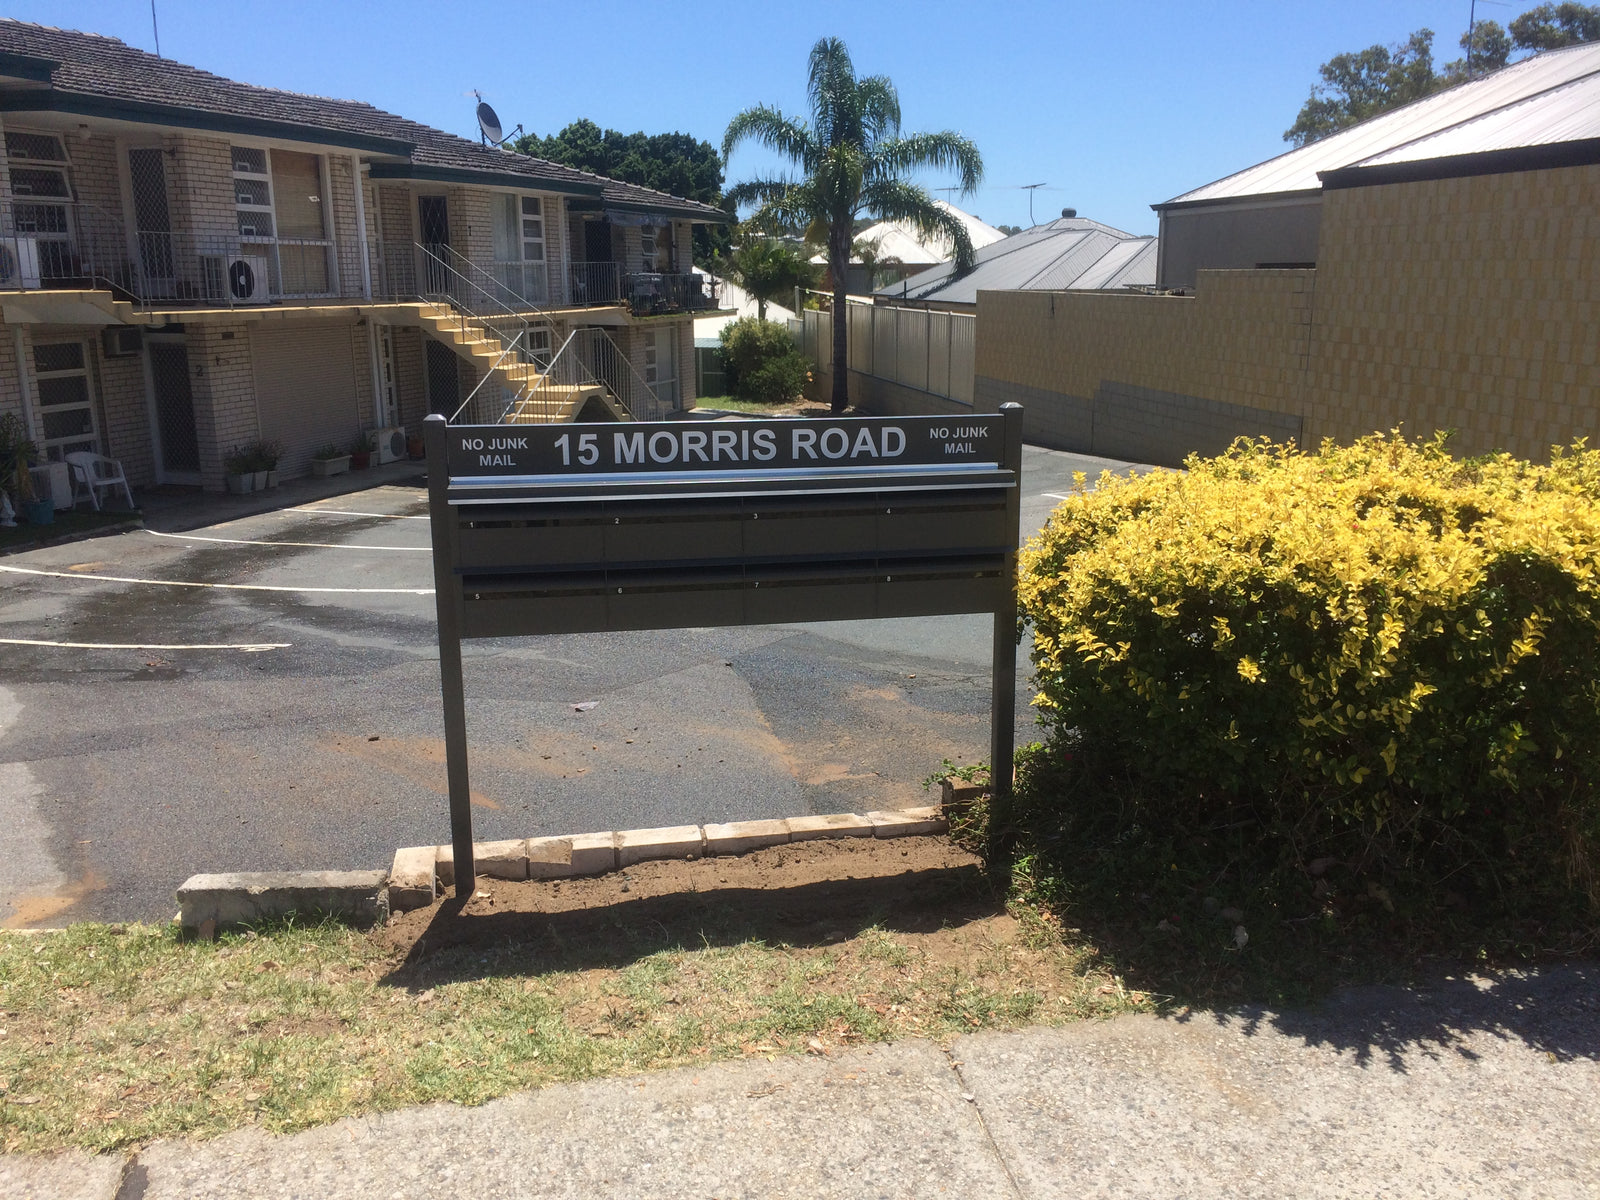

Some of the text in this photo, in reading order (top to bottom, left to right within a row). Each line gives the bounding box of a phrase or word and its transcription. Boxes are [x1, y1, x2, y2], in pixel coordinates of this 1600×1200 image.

[930, 426, 988, 439] NO JUNK
[462, 437, 528, 451] NO JUNK
[554, 426, 906, 466] 15 MORRIS ROAD
[945, 442, 976, 454] MAIL
[479, 454, 516, 466] MAIL
